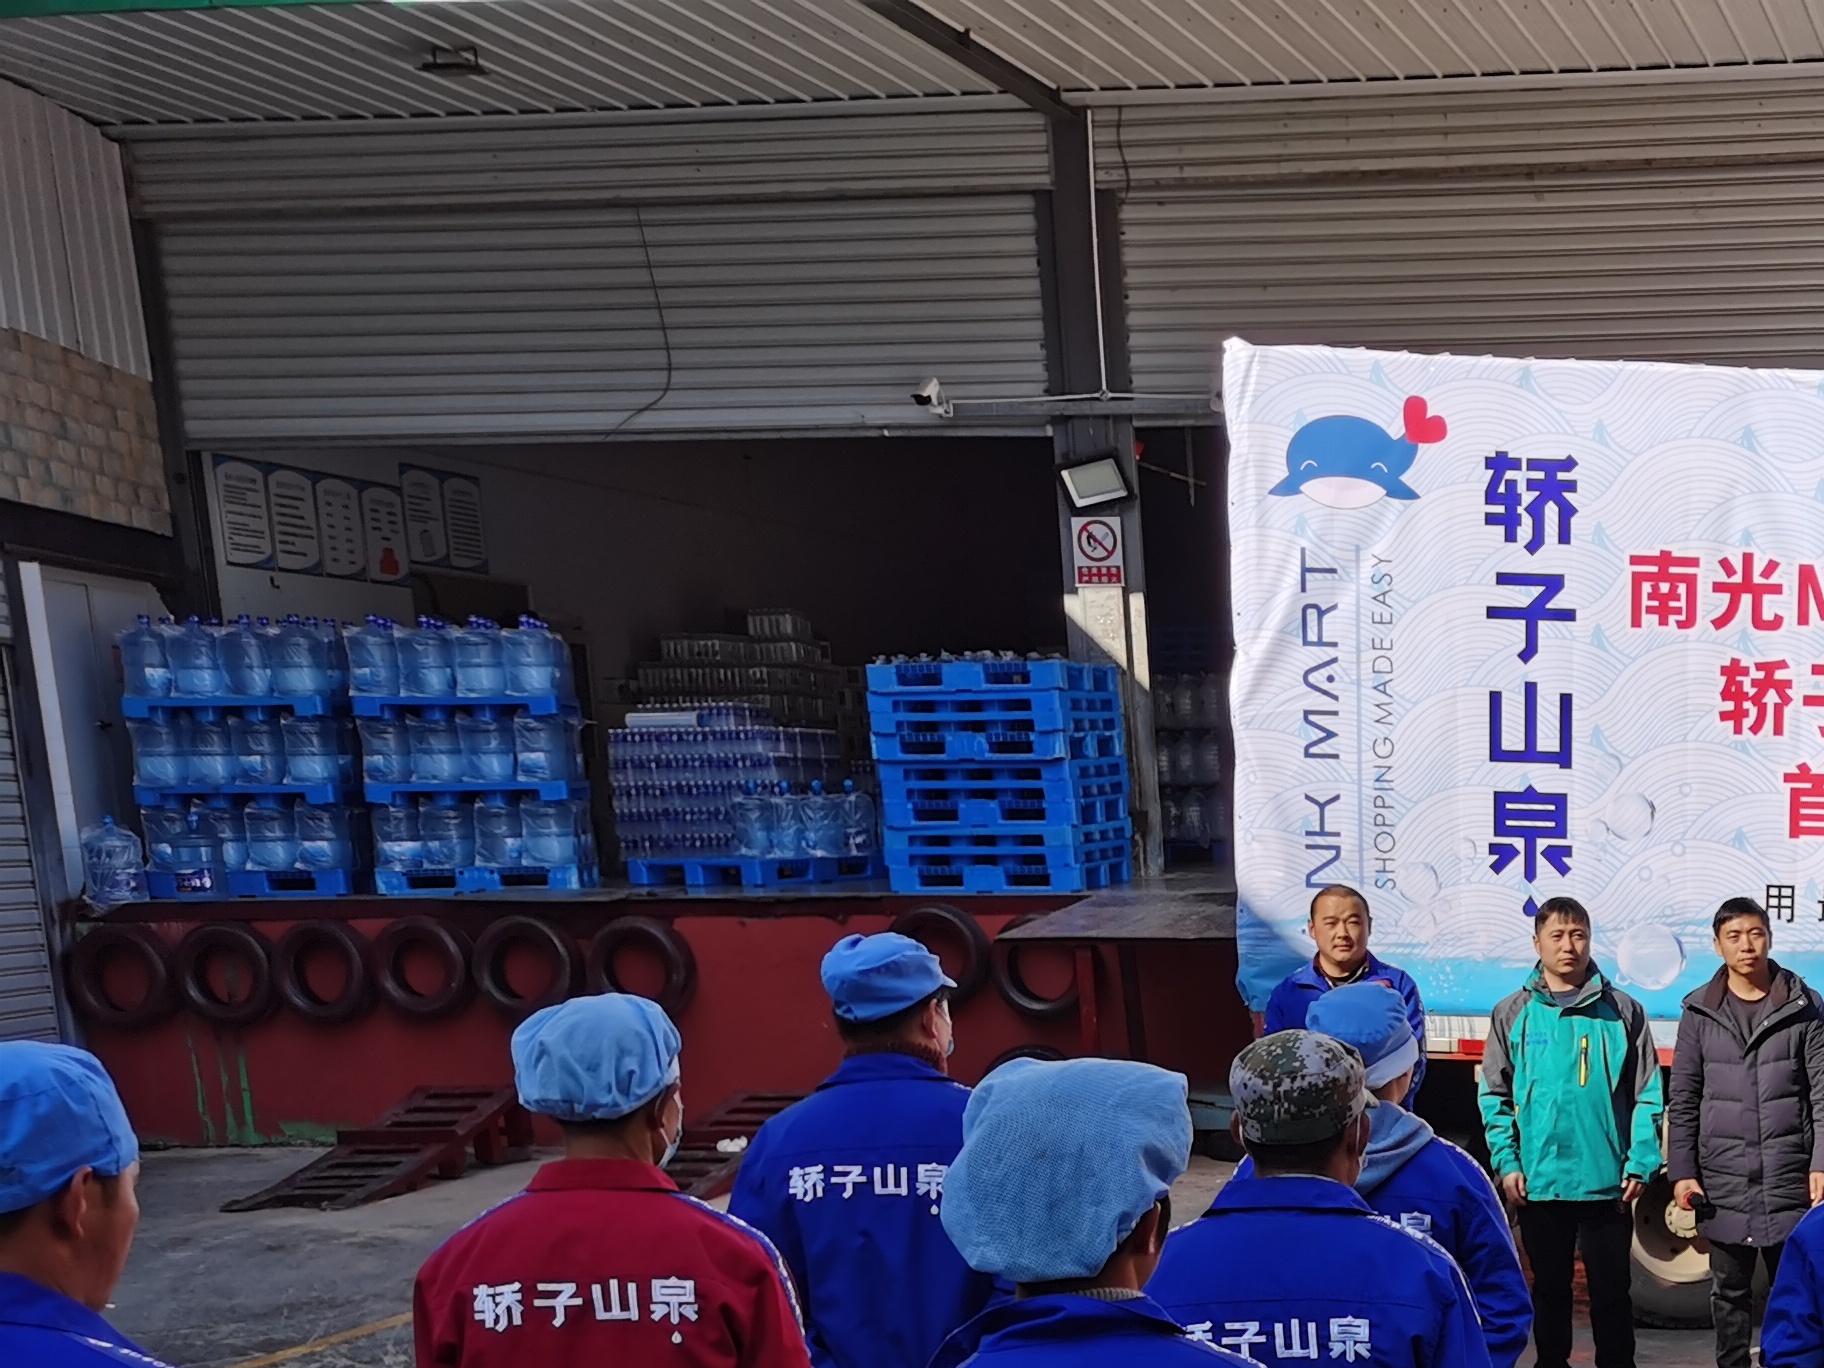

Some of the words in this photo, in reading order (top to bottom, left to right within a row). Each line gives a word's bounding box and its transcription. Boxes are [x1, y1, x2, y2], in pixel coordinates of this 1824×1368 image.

[1371, 554, 1393, 625] EASY
[1300, 546, 1340, 759] MART
[1372, 637, 1394, 725] MADE
[1485, 450, 1579, 881] 轿子山泉
[1304, 793, 1341, 889] NK
[1373, 736, 1396, 890] SHOPPING
[788, 1162, 949, 1203] 轿子山泉
[473, 1275, 700, 1331] 轿子山泉
